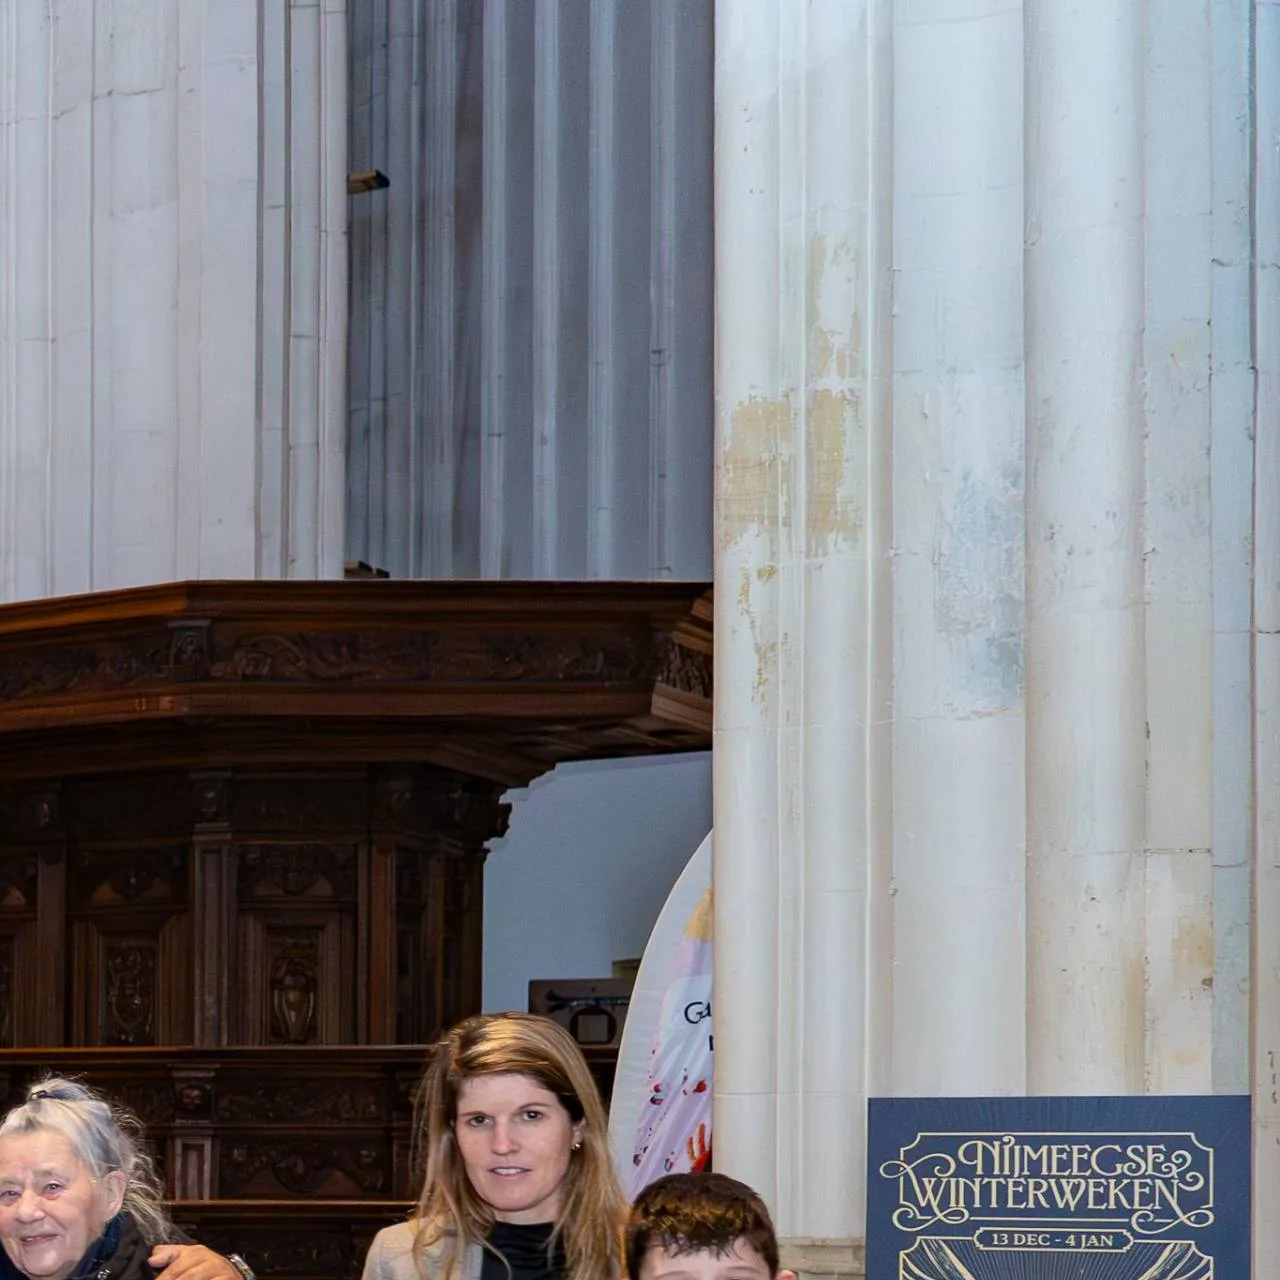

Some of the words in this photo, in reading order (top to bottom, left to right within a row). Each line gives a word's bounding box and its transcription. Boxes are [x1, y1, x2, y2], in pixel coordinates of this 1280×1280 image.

[958, 1135, 1198, 1183] NIJMEEGSE
[892, 1167, 1192, 1218] WINTERWEKEN
[992, 1233, 1008, 1246] 13
[1013, 1233, 1050, 1246] DEC
[1065, 1233, 1077, 1247] 4
[1080, 1234, 1113, 1249] JAN
